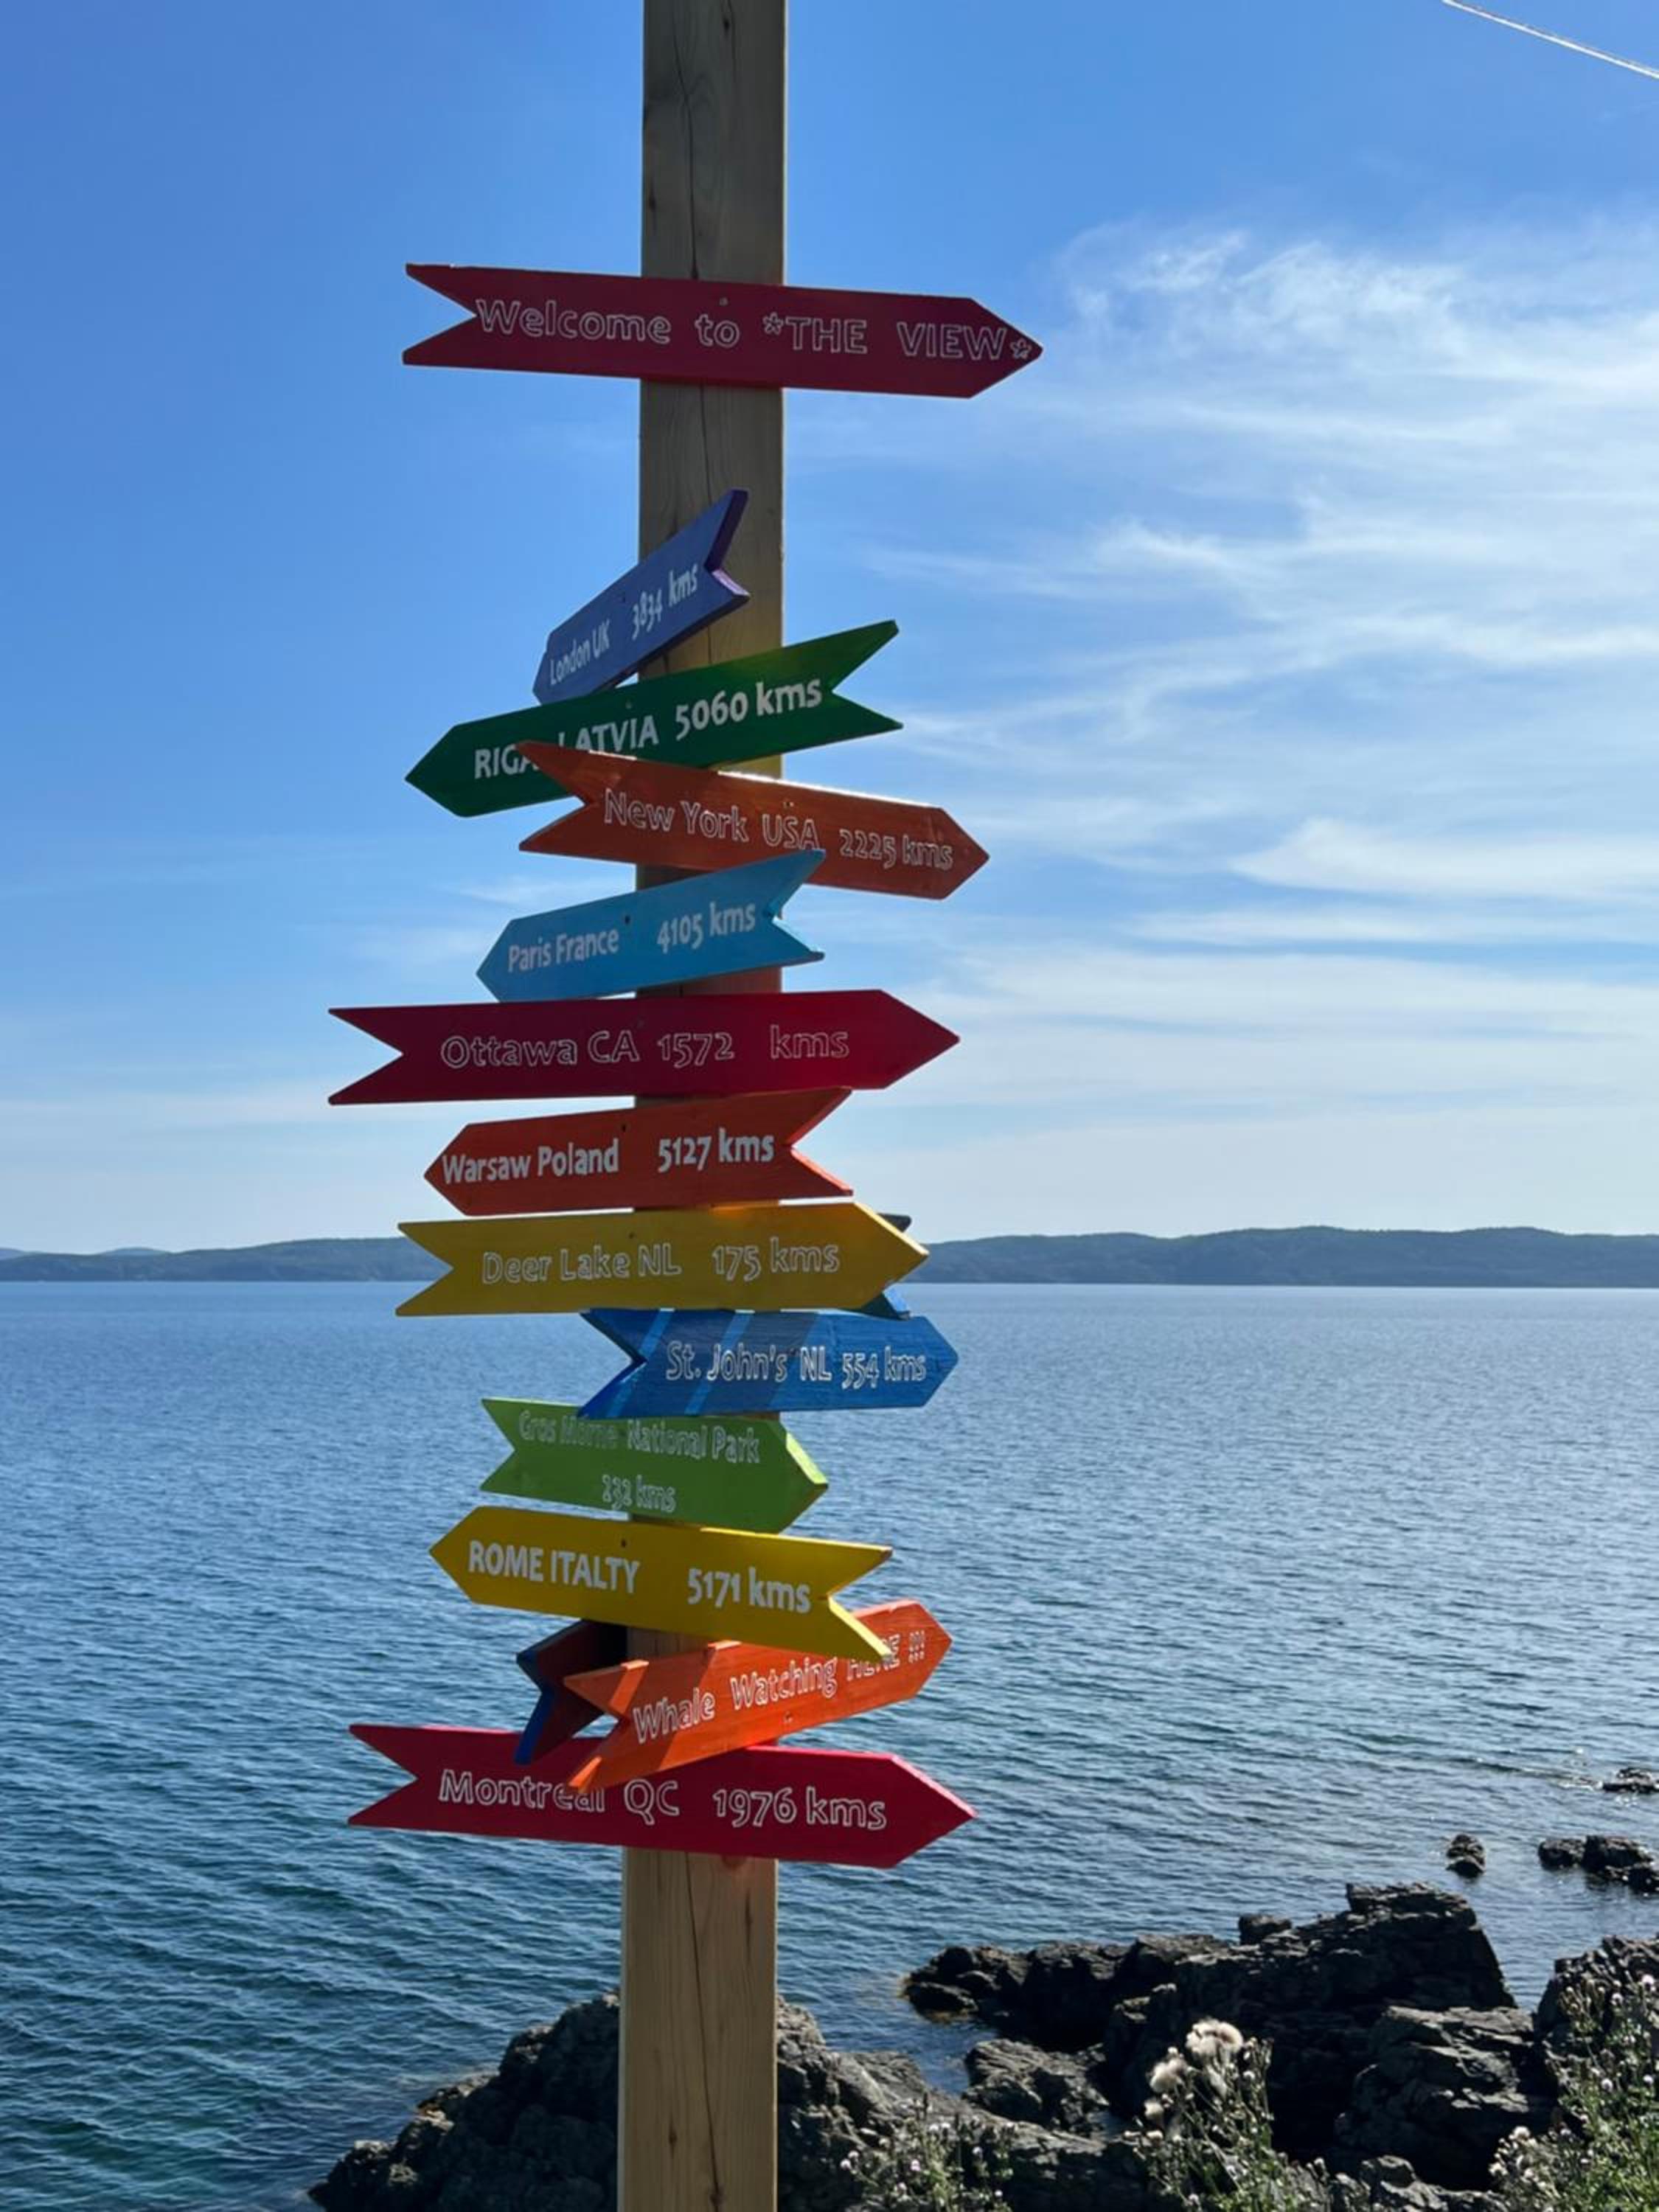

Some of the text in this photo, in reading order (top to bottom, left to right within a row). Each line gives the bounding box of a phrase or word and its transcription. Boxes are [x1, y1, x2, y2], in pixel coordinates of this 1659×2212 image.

[476, 299, 671, 344] Welcome
[695, 314, 740, 347] to
[550, 563, 698, 685] London UK 3834 kms
[675, 690, 748, 740] 5060
[755, 678, 822, 717] kms
[604, 788, 953, 871] New York USA 2225 kms
[508, 902, 756, 973] Paris France 4105 kms
[442, 1026, 849, 1068] Ottawa CA 1572 kms
[442, 1127, 774, 1183] Warsaw Poland 5127 kms
[482, 1237, 839, 1284] Deer Lake NL 175 kms
[667, 1340, 926, 1389] St. John's NL 554 kms
[519, 1410, 556, 1442] Gros
[627, 1419, 705, 1458] National
[712, 1426, 759, 1463] Park
[636, 1475, 675, 1512] kms
[469, 1540, 810, 1613] ROME ITALTY 5171 kms
[633, 1688, 715, 1743] Whale
[731, 1657, 837, 1709] Watching
[439, 1770, 886, 1829] Montreal QC 1976 kms
